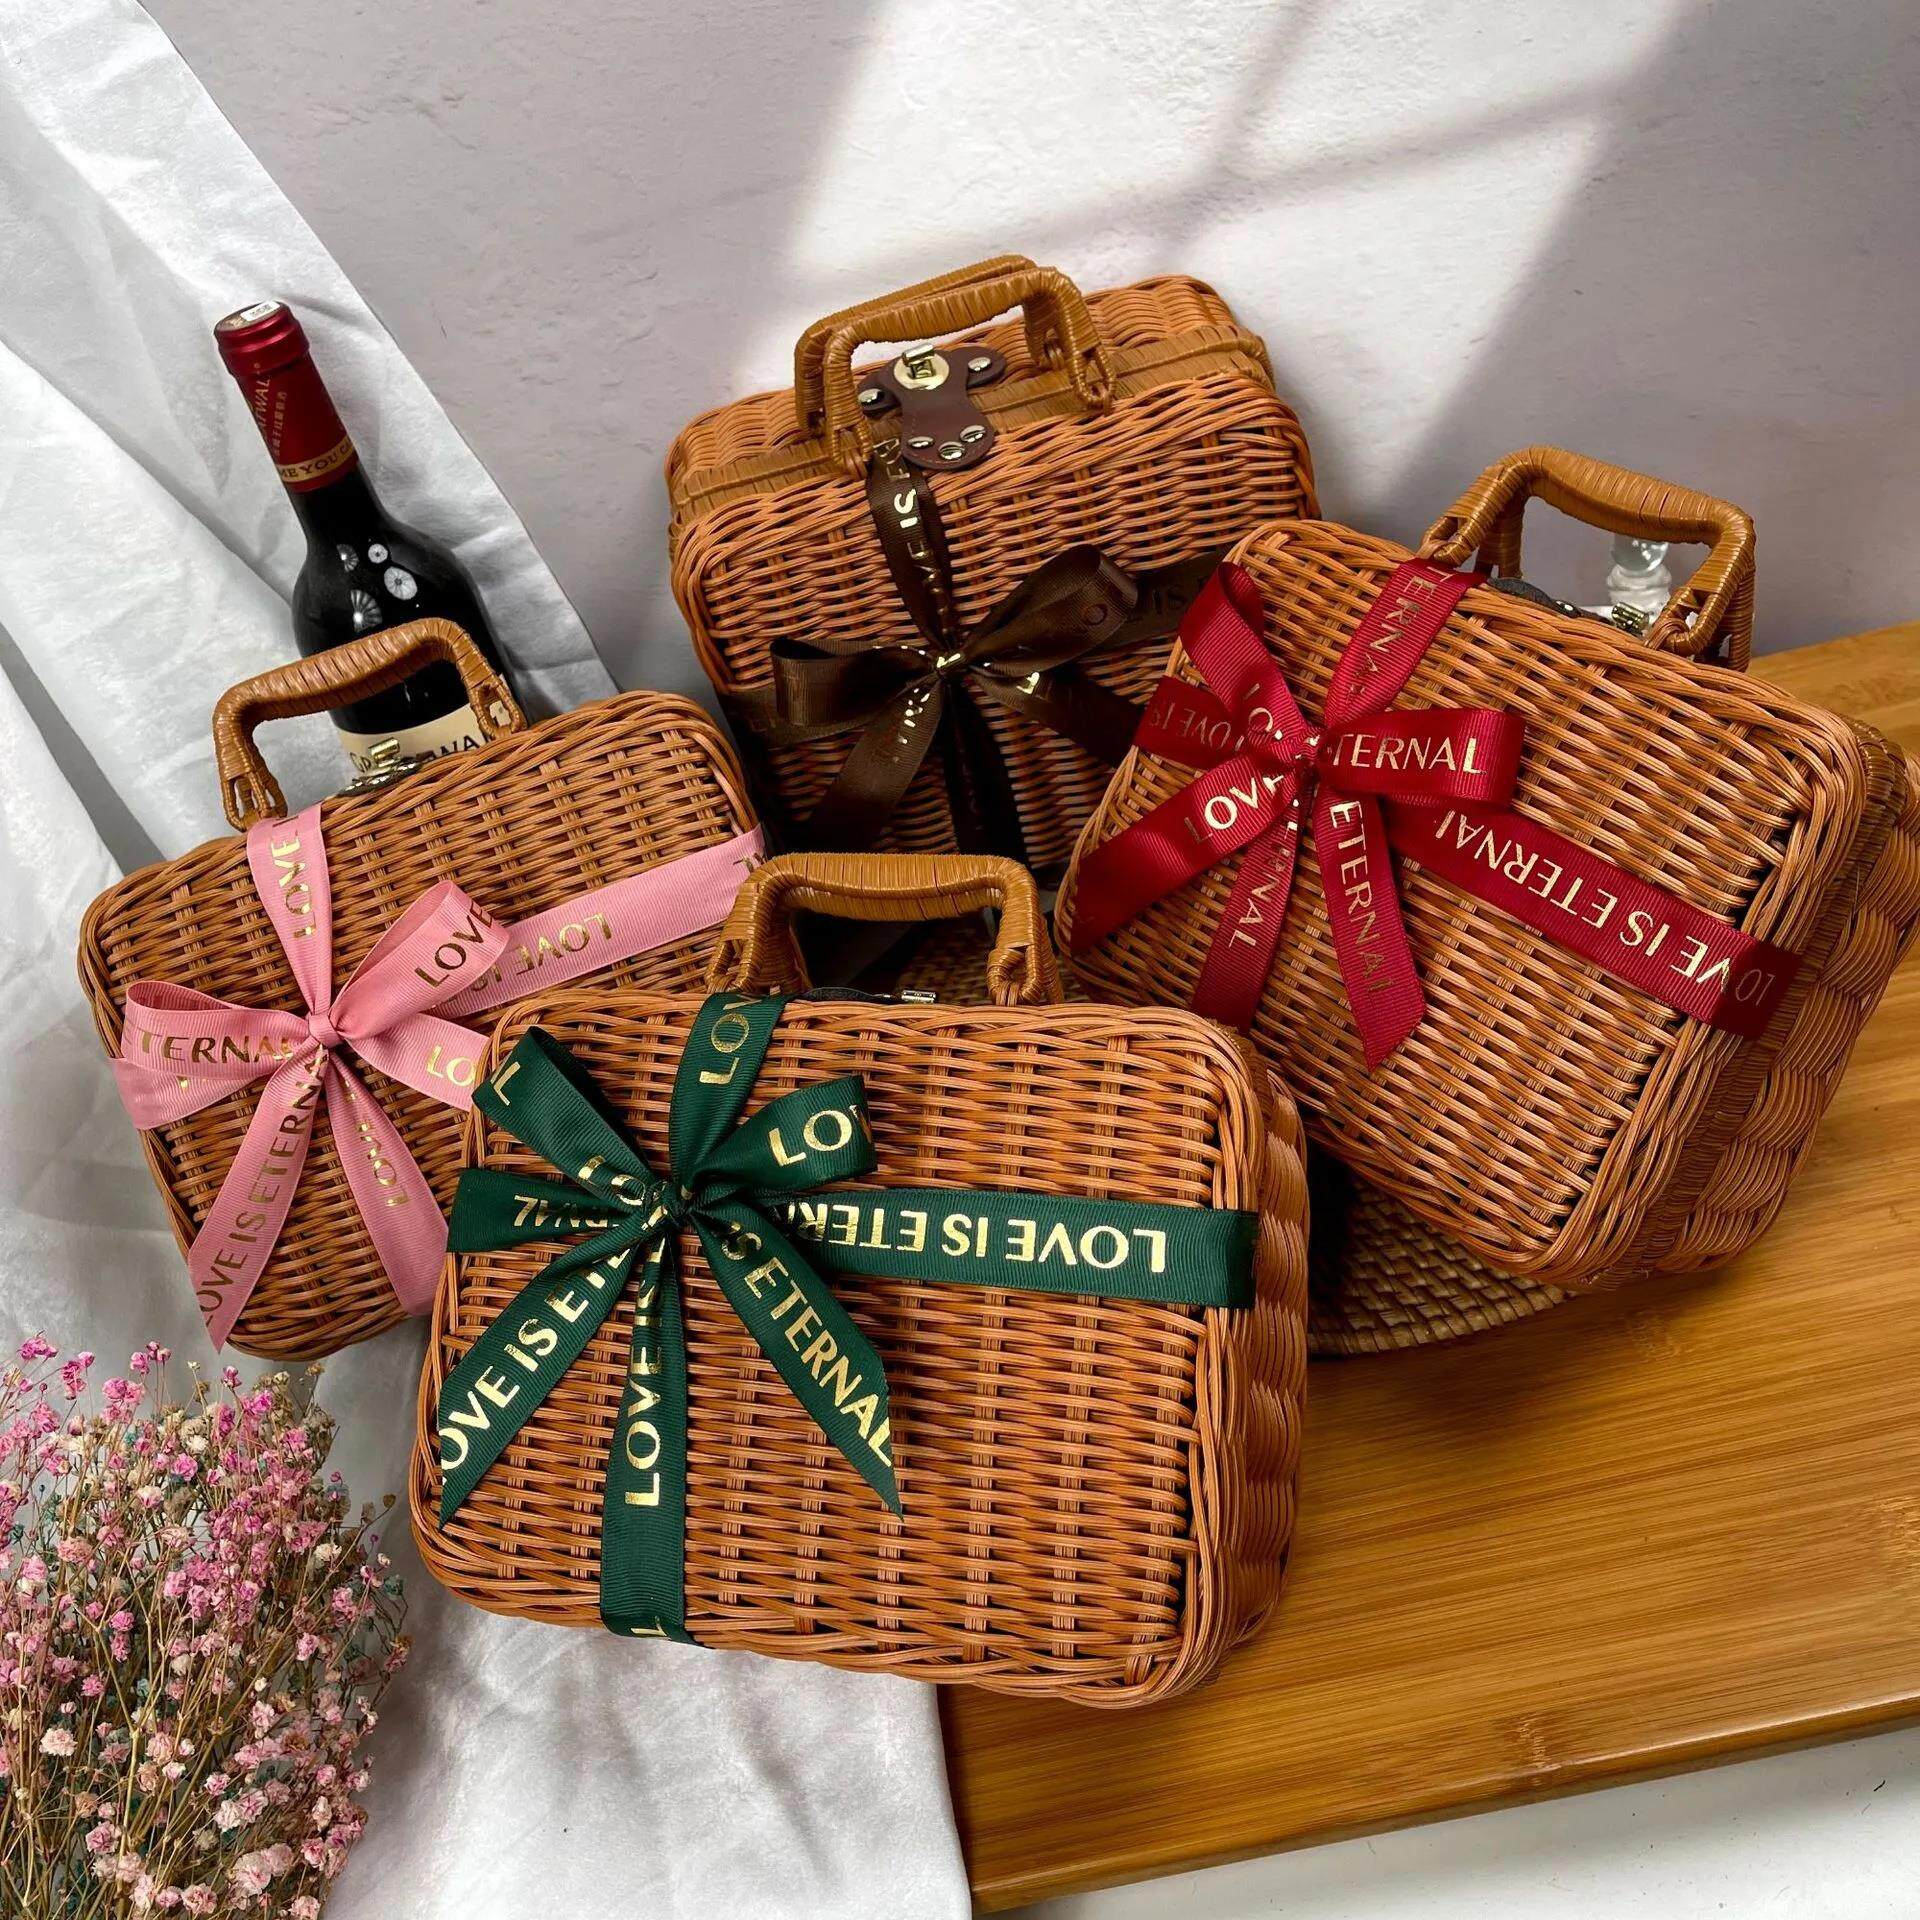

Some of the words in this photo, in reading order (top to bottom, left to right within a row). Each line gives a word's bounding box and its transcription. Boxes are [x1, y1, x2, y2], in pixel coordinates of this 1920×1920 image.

[1331, 733, 1487, 774] TERNAL
[271, 830, 317, 938] LOVE
[414, 902, 496, 989] LOVE
[516, 912, 613, 976] LOVE
[1619, 909, 1670, 957] IS
[427, 1044, 476, 1087] LO
[941, 1213, 989, 1258] IS
[1005, 1219, 1167, 1274] LOVE
[196, 1249, 249, 1327] OVE
[229, 1210, 267, 1244] IS
[744, 1257, 892, 1468] ETERNAL
[439, 1365, 520, 1482] OVE
[503, 1318, 559, 1372] IS
